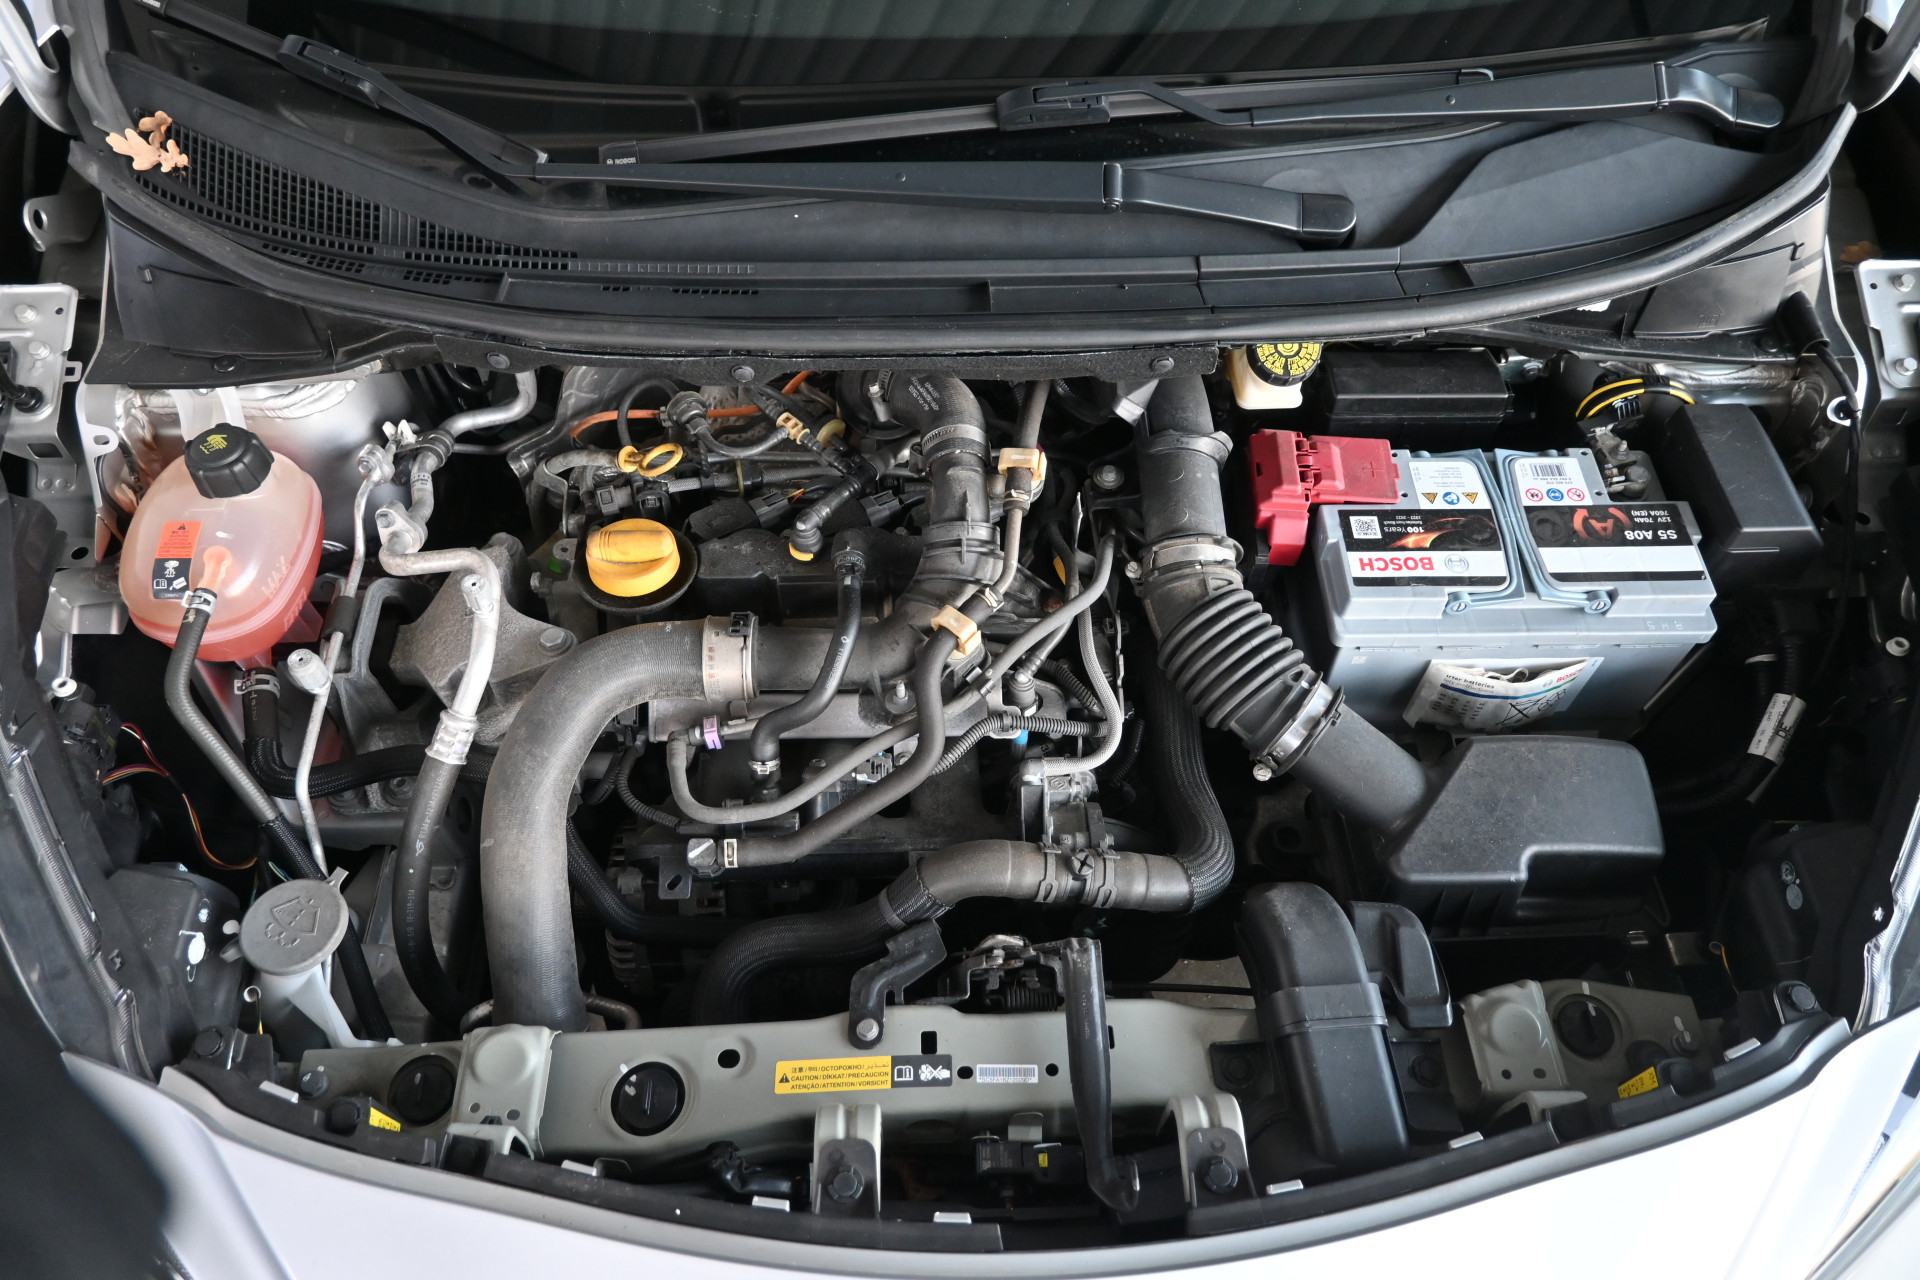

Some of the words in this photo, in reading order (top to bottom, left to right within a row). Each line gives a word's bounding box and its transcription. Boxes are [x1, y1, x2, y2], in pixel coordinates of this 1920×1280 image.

[1624, 529, 1653, 540] A08
[1657, 529, 1678, 540] S5
[1358, 556, 1435, 572] BOSCH
[790, 1074, 819, 1082] CAUTION
[820, 1081, 856, 1089] ATTENTION
[857, 1079, 889, 1087] VORSICHT
